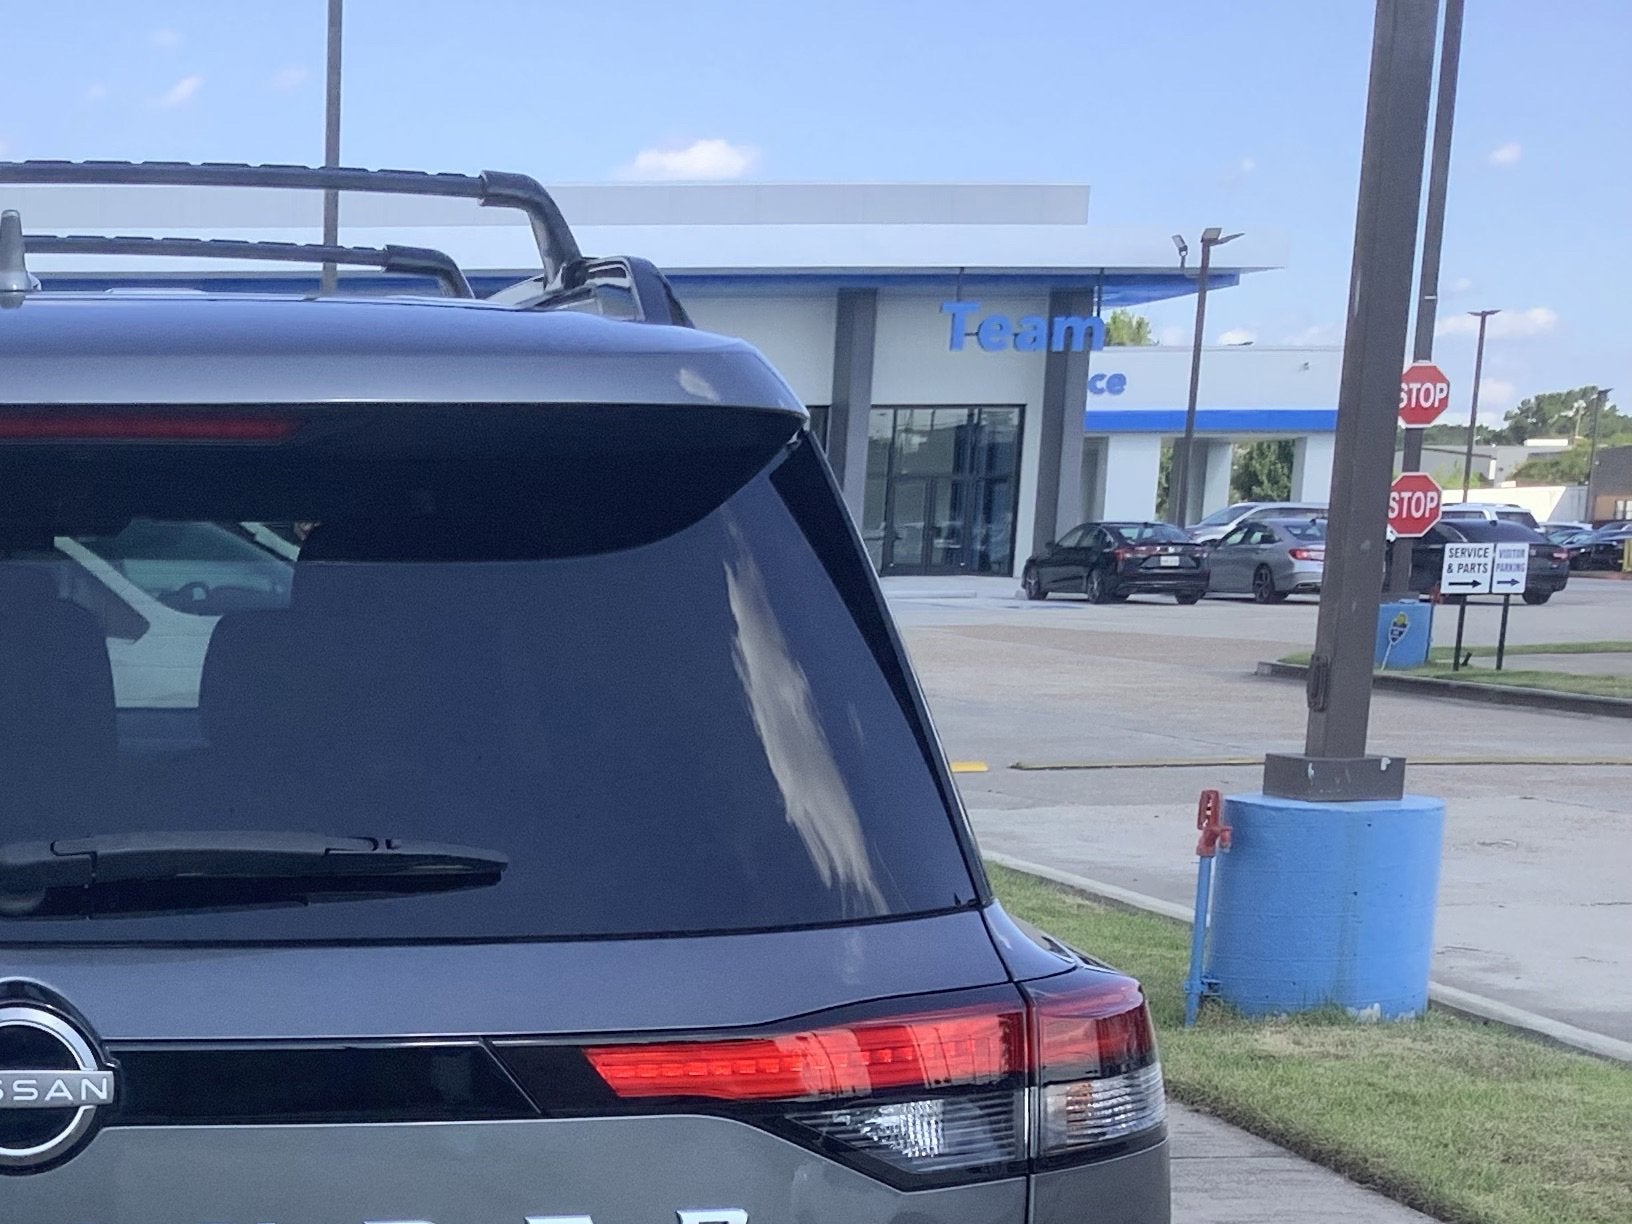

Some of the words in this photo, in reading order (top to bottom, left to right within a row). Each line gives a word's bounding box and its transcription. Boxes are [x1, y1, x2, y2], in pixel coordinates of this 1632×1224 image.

[941, 302, 1105, 352] Team
[1399, 382, 1448, 409] STOP
[1388, 490, 1438, 518] STOP
[1448, 547, 1489, 558] SERVICE
[1446, 563, 1453, 574] &
[1457, 563, 1488, 574] PARTS
